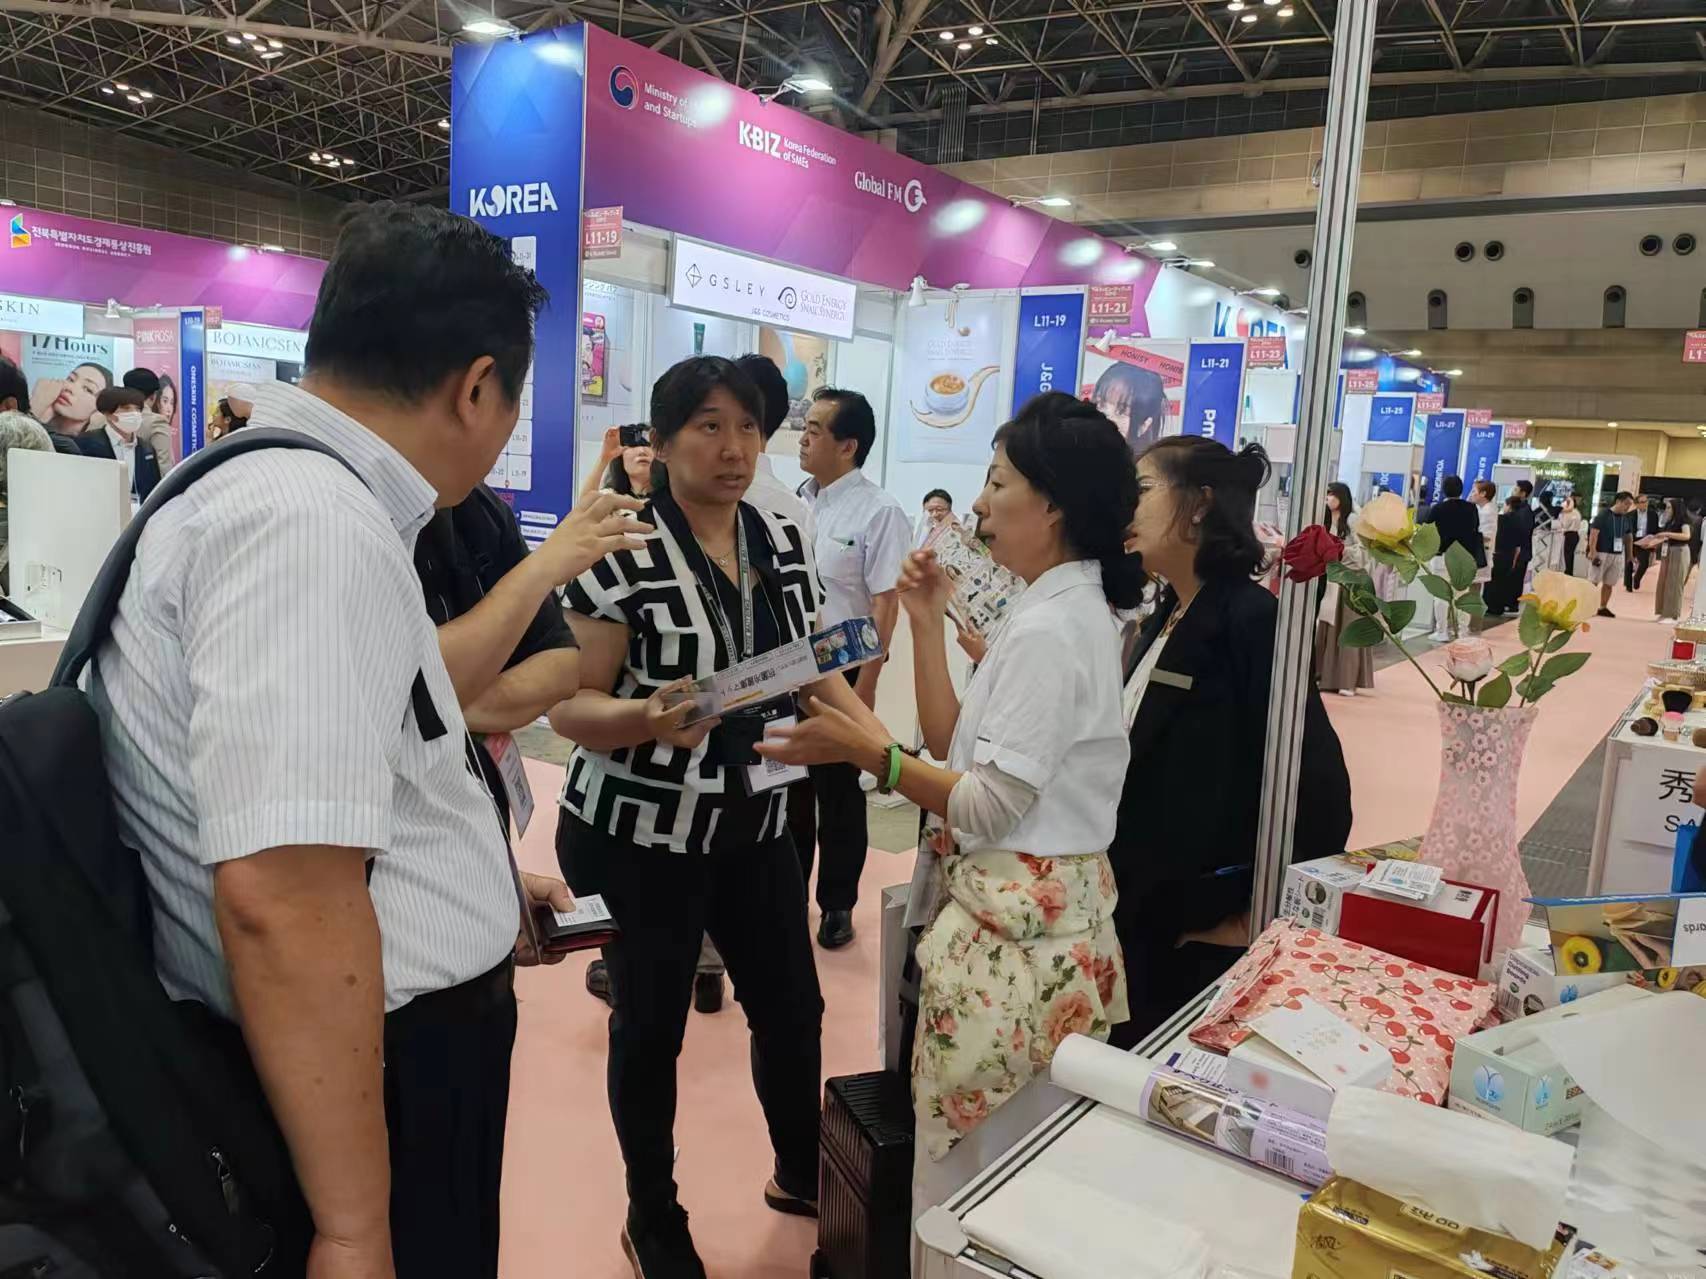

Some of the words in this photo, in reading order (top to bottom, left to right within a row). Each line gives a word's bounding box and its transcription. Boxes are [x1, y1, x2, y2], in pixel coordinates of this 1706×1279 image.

[644, 82, 678, 106] Ministry
[680, 97, 689, 106] of
[644, 101, 661, 115] and
[663, 105, 698, 128] Startups
[783, 137, 803, 153] Korea
[803, 144, 837, 166] Federation
[783, 152, 791, 162] of
[791, 153, 809, 169] SMEs
[854, 170, 886, 198] Global
[888, 182, 903, 204] FM
[469, 182, 559, 218] KOREA
[585, 230, 618, 246] L11-19
[709, 273, 766, 297] GSLEY
[1091, 302, 1127, 314] L11-21
[1034, 314, 1067, 327] L11-19
[1121, 349, 1149, 364] HONIST
[1201, 358, 1230, 369] L11-21
[1250, 349, 1281, 359] L11-23
[190, 365, 198, 405] ONESKIN
[1435, 421, 1456, 429] L11-27
[1658, 768, 1697, 804] 秀
